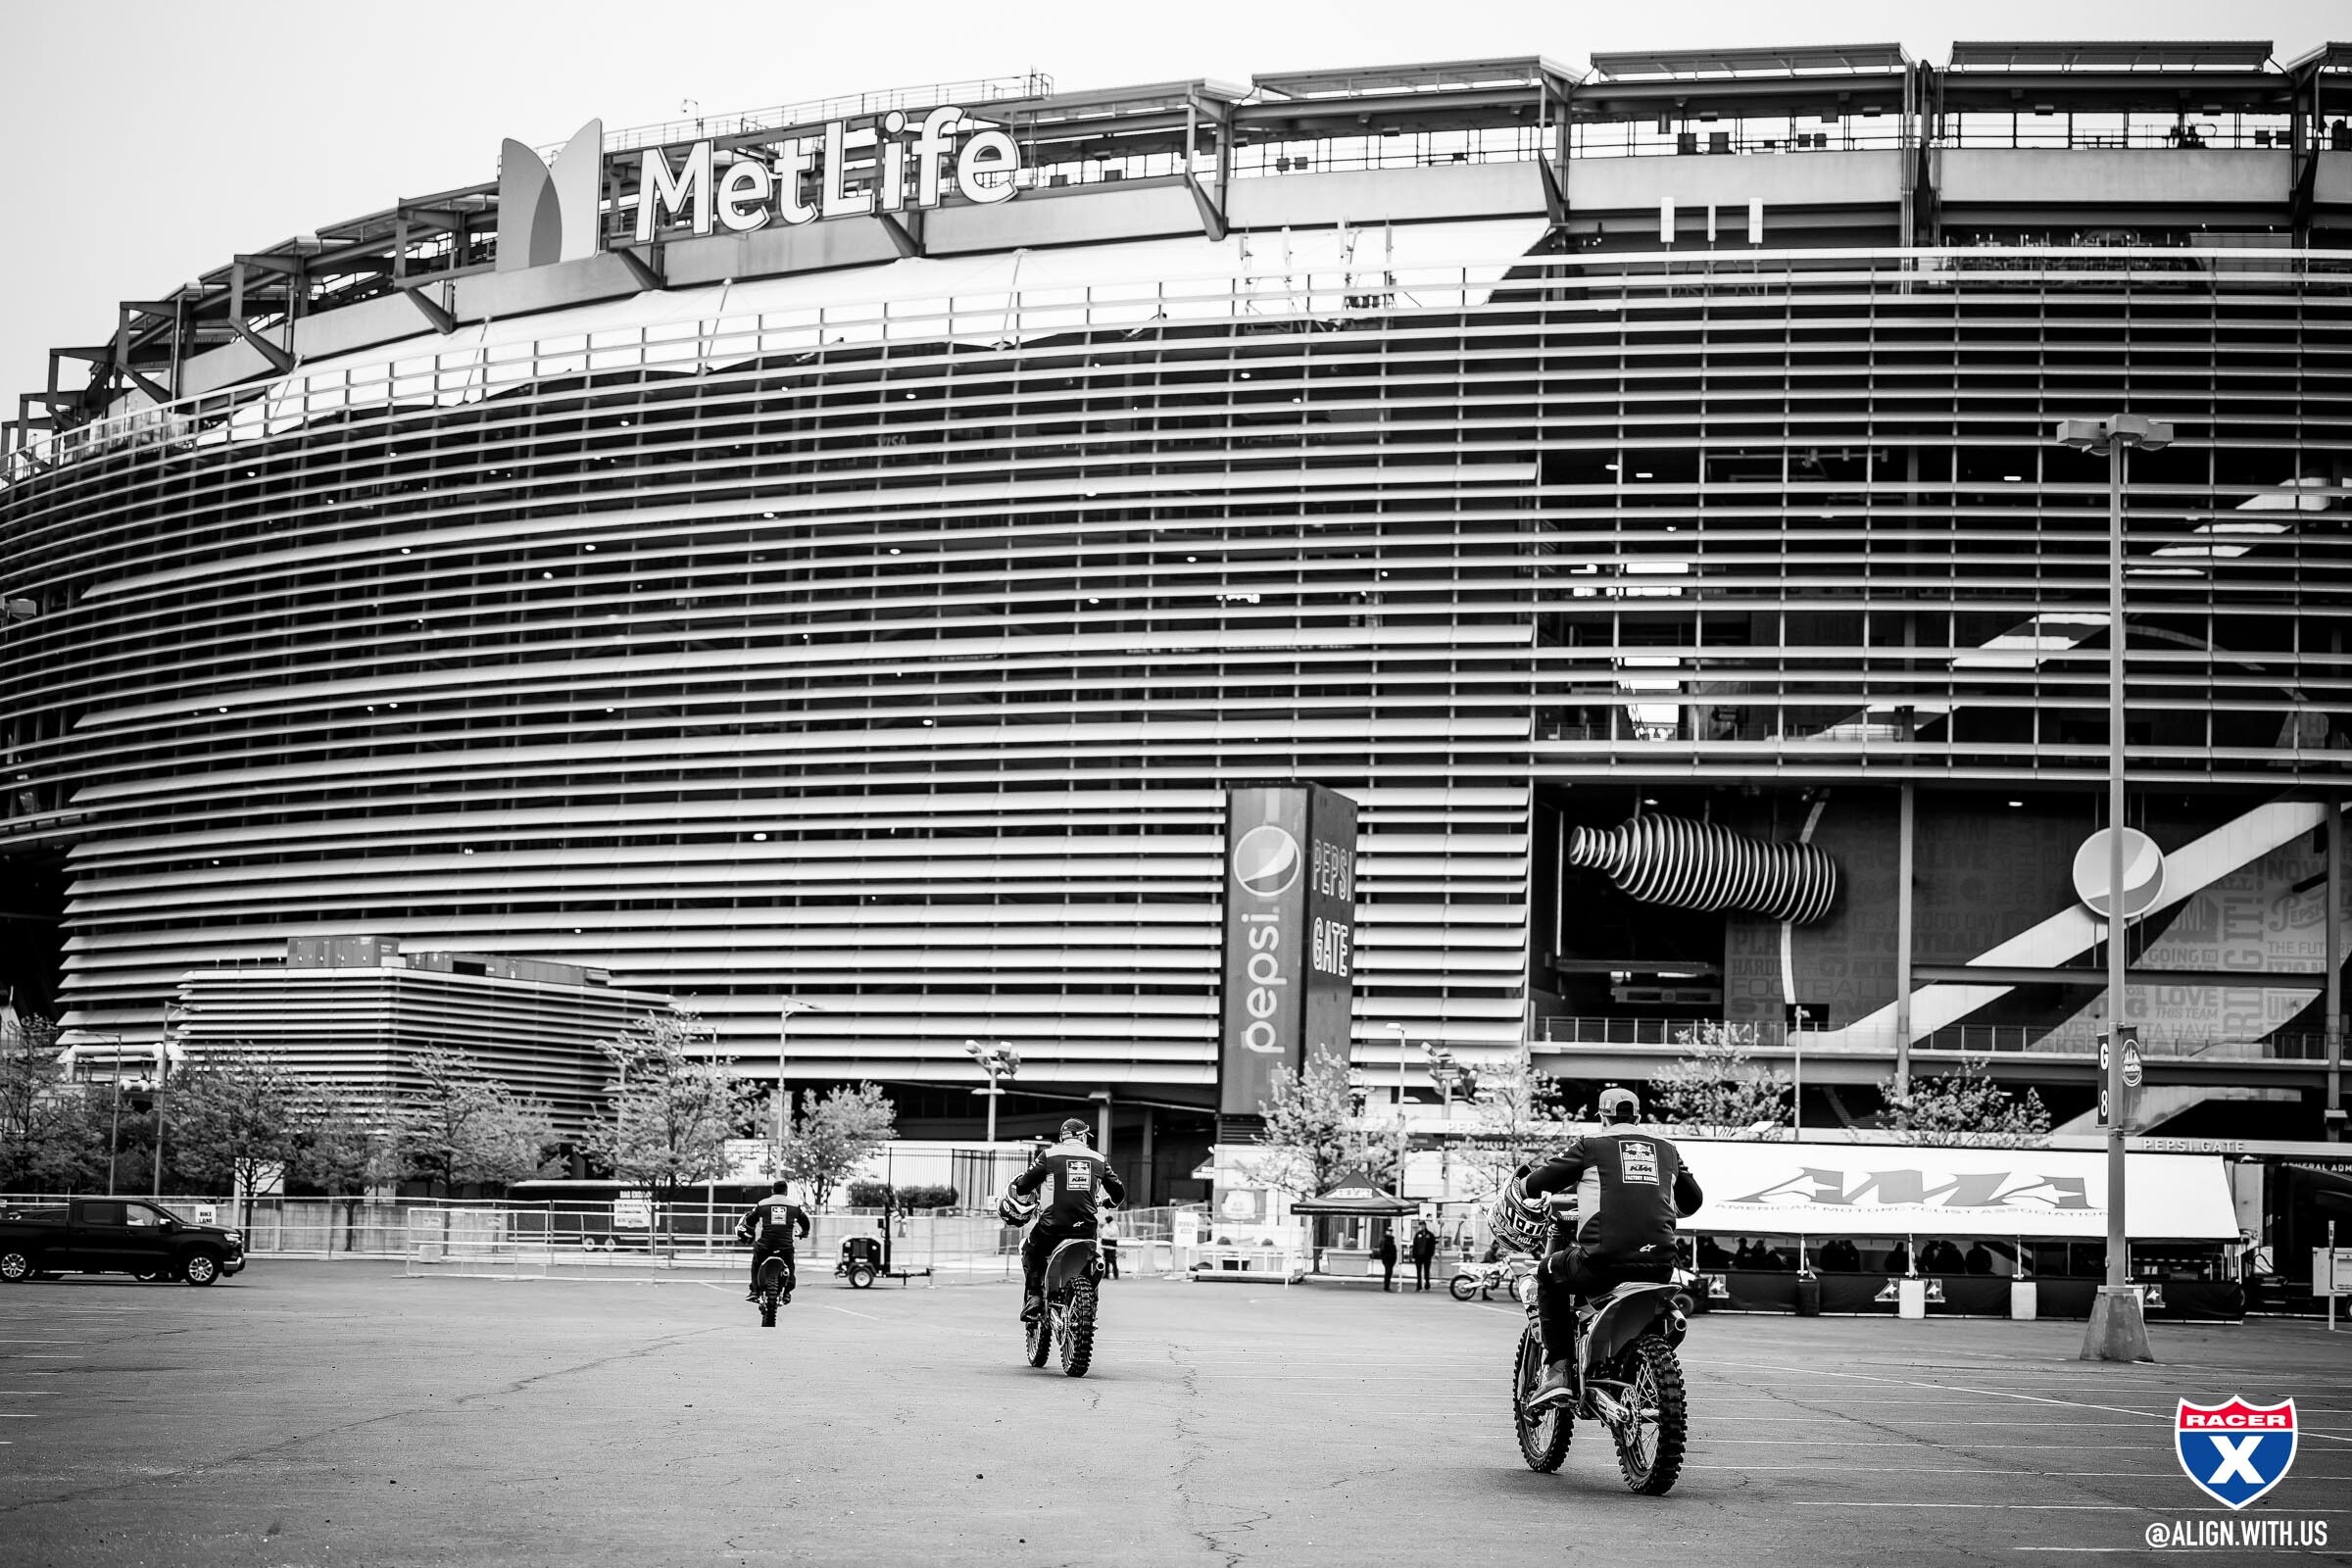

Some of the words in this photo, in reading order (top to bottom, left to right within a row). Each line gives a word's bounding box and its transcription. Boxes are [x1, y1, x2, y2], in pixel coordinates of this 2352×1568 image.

[634, 104, 1022, 243] MetLife
[1312, 838, 1353, 903] PEPSI
[1312, 916, 1349, 978] GATE
[2148, 948, 2199, 963] GOING
[1241, 912, 1288, 1054] pepsi
[2155, 987, 2219, 1006] LOVE
[2100, 1043, 2109, 1070] G
[2100, 1090, 2108, 1117] 8
[2142, 1139, 2193, 1152] PEPSI
[2201, 1141, 2246, 1153] GATE
[1629, 1164, 1652, 1173] KTM
[1723, 1166, 2097, 1209] AMA
